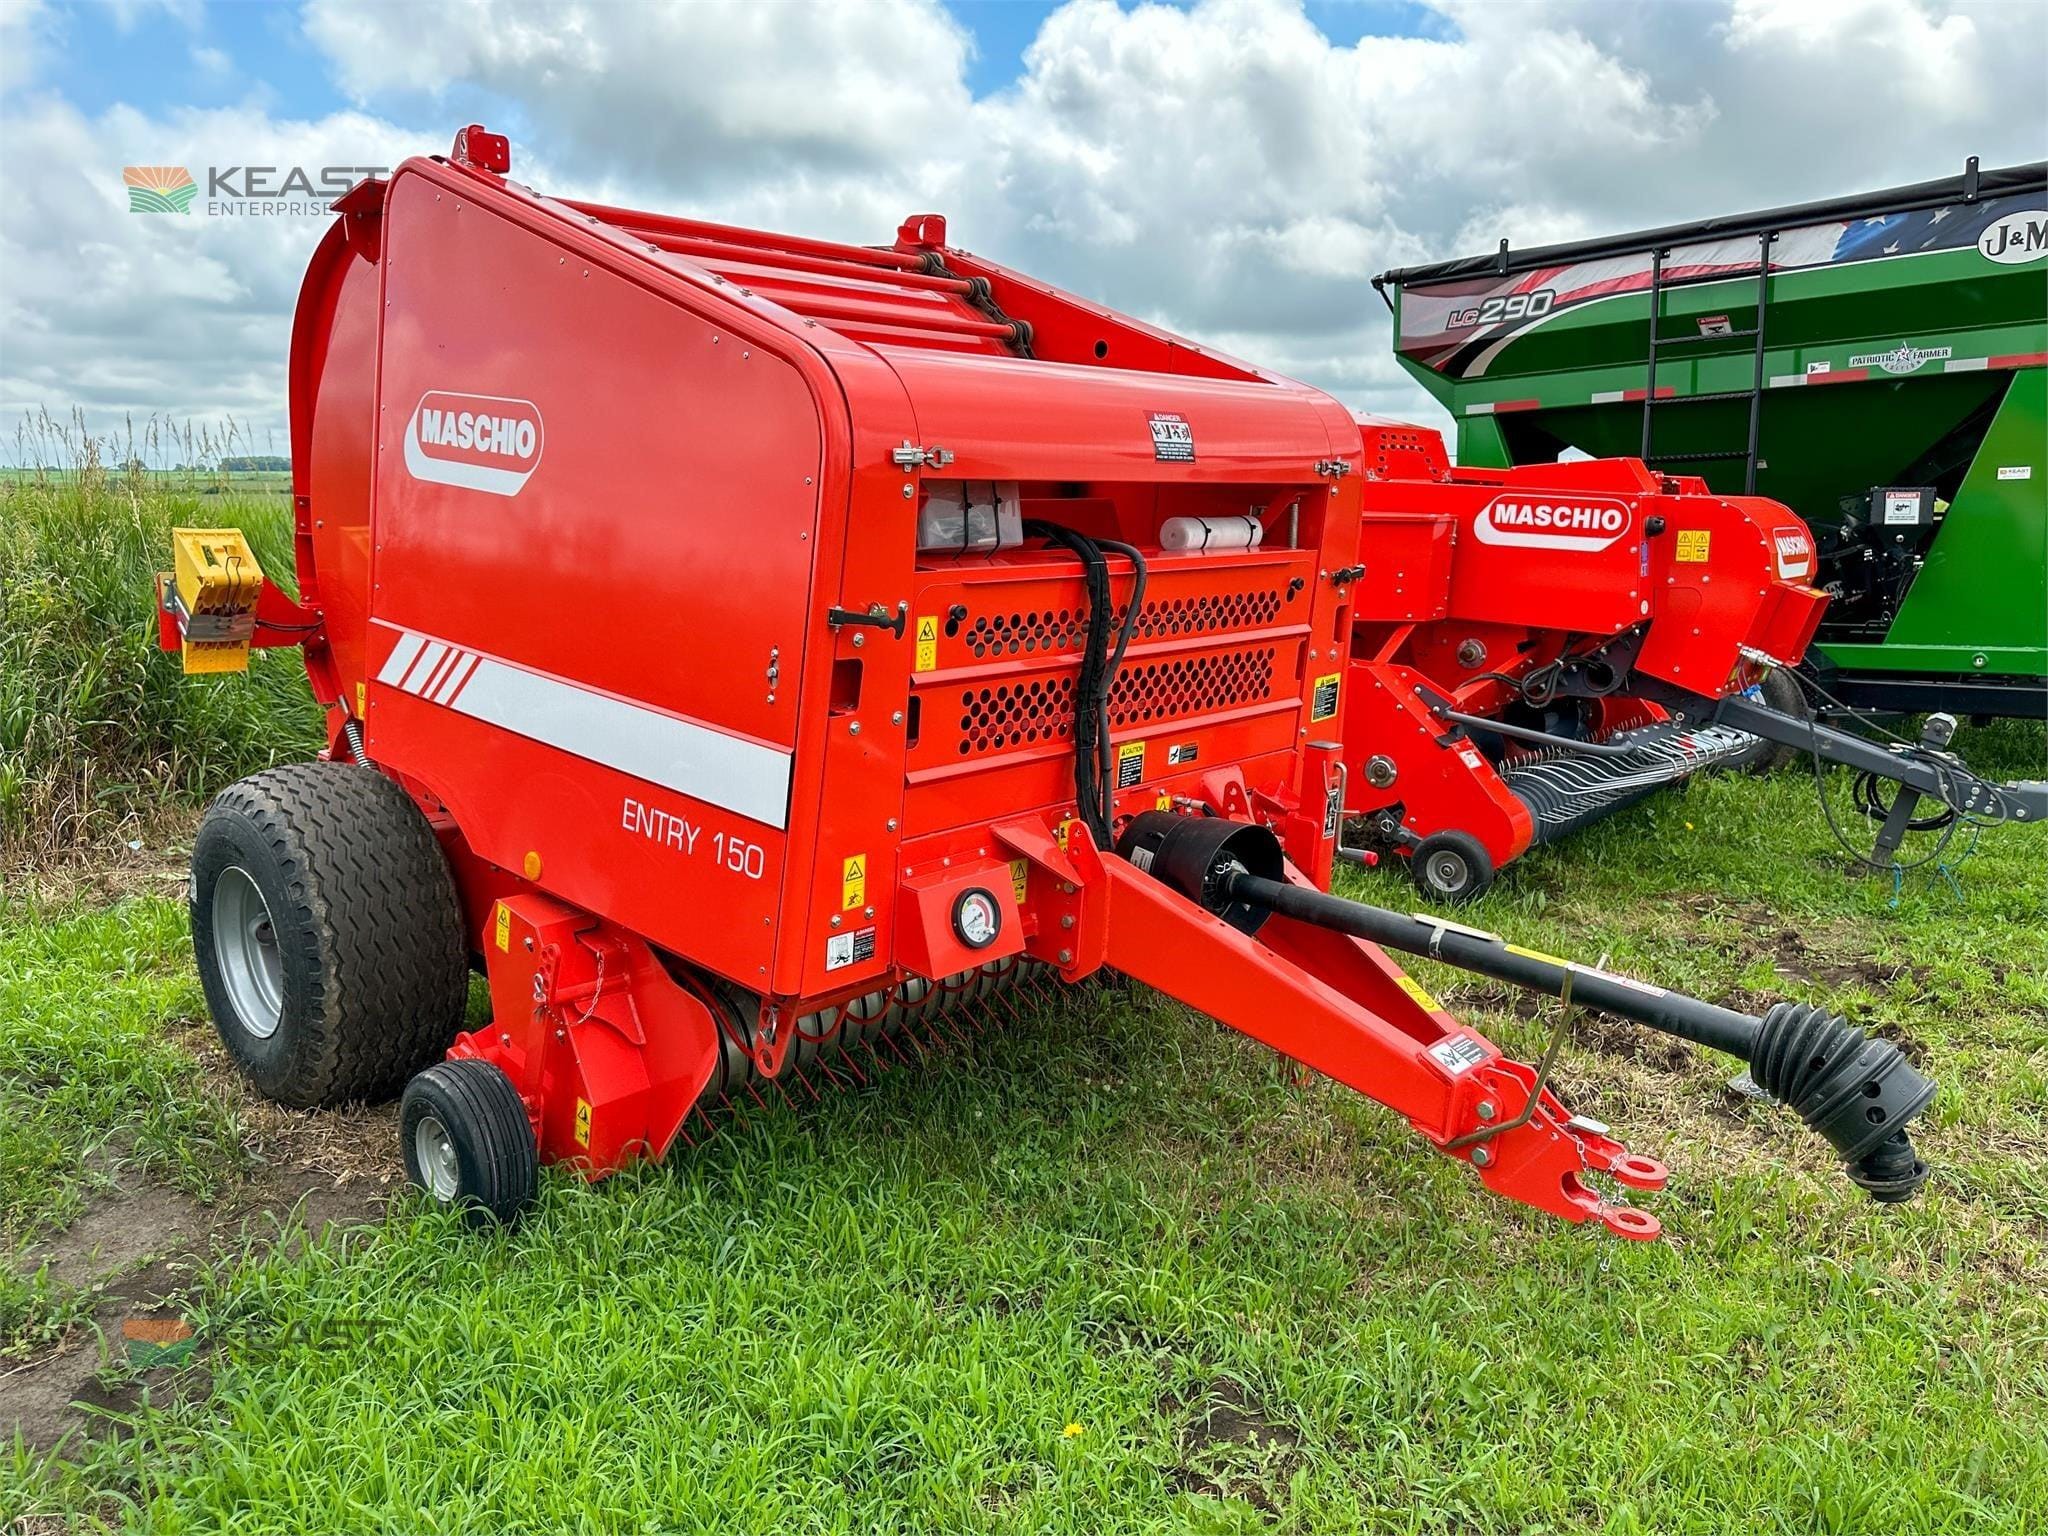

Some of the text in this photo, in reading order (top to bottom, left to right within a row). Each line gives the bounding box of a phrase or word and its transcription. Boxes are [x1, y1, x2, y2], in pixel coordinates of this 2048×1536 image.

[1852, 349, 1948, 366] PATRIOTIC FARMER
[421, 408, 536, 459] MASCHIO
[1494, 503, 1623, 531] MASCHIO
[622, 797, 765, 880] ENTRY 150
